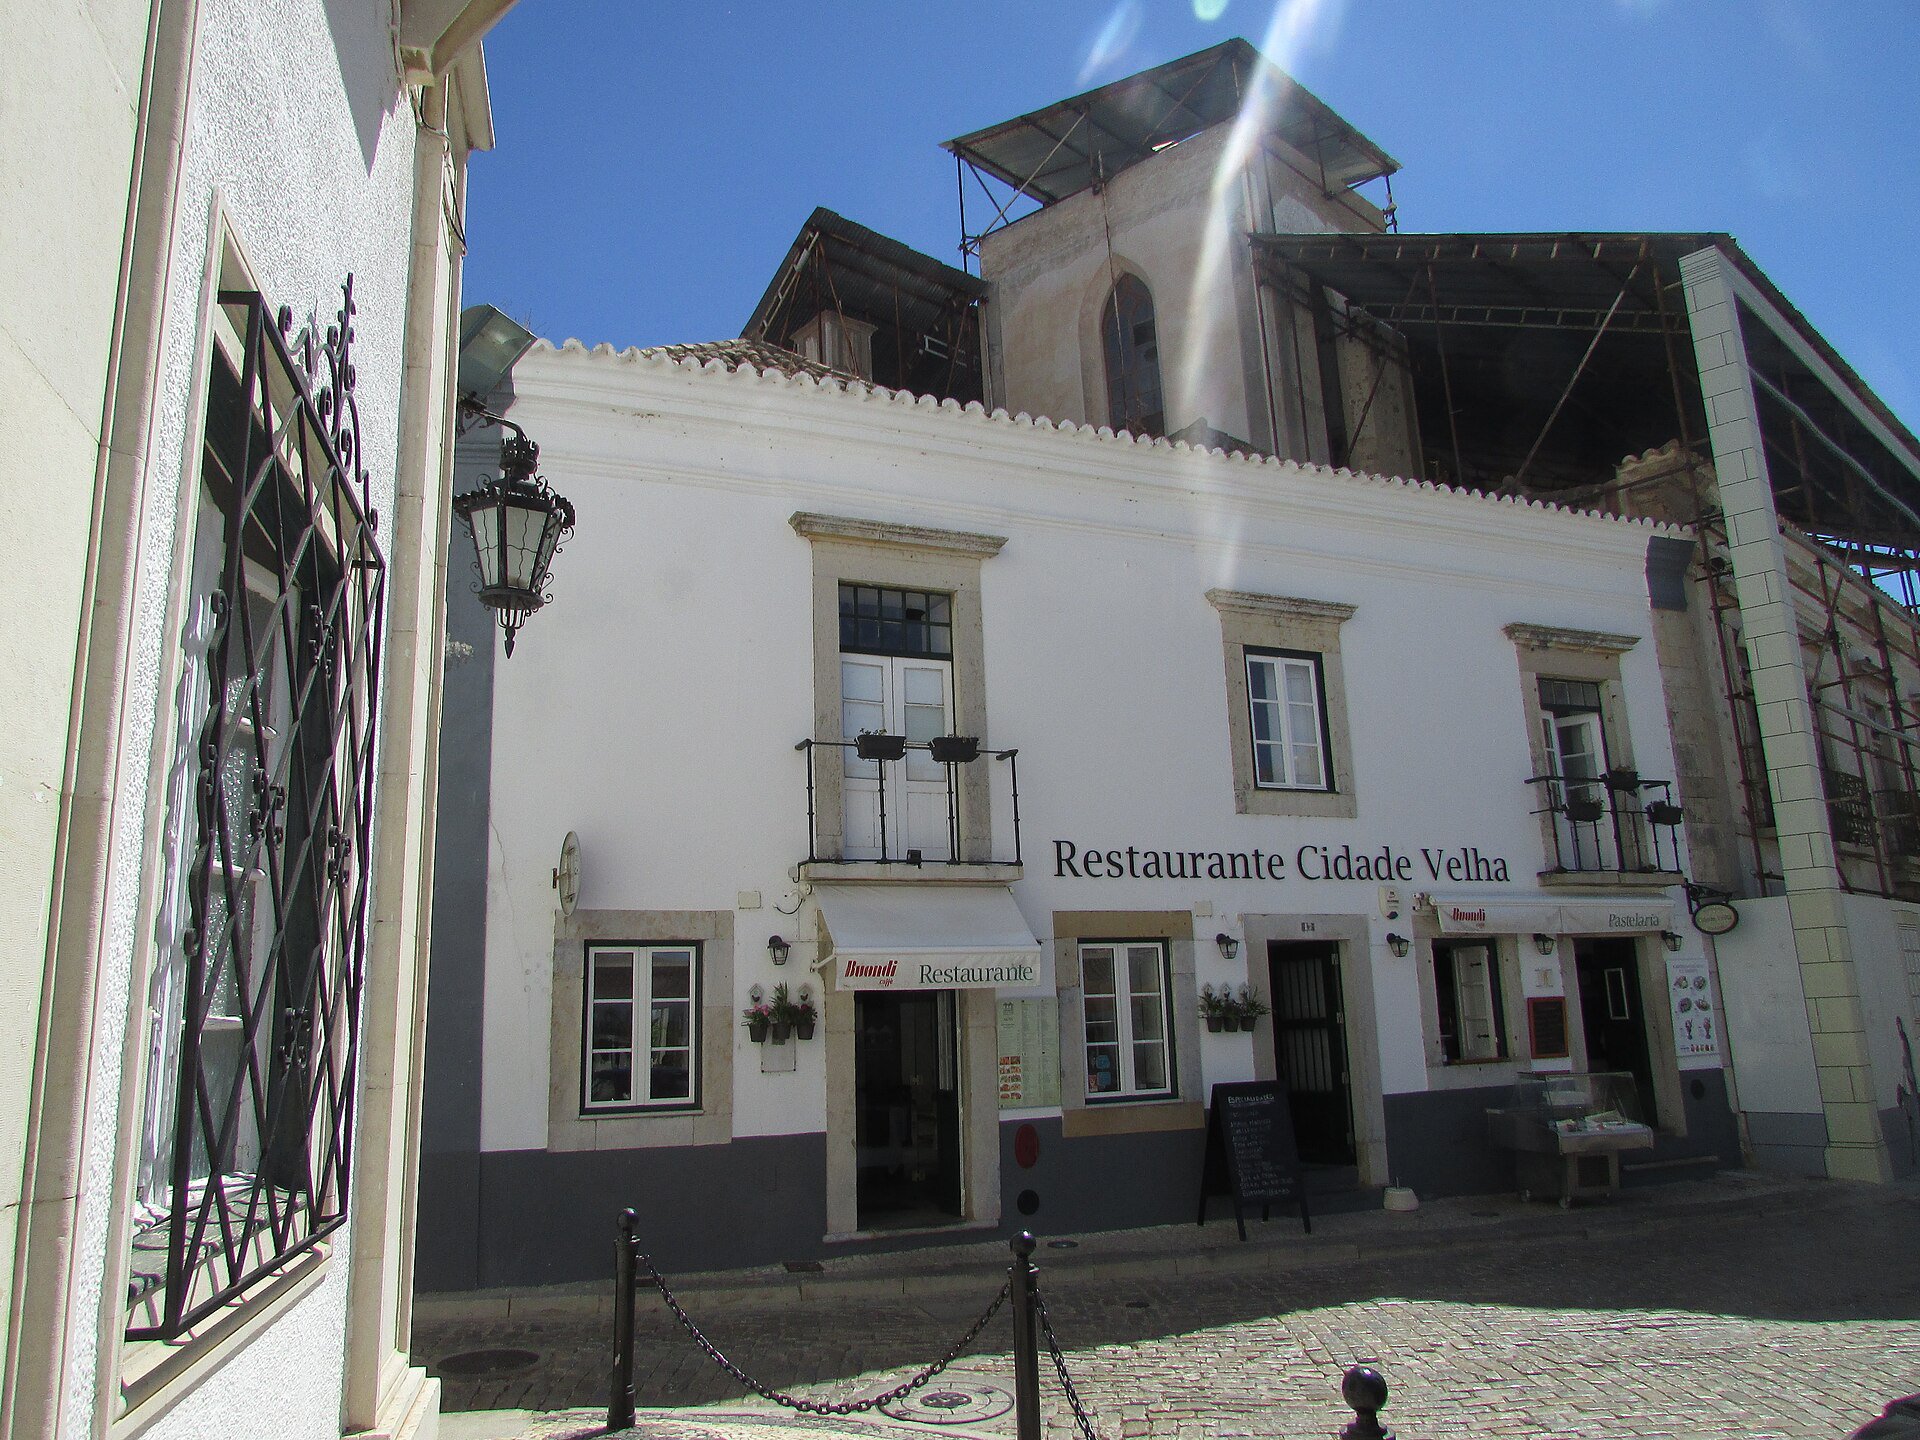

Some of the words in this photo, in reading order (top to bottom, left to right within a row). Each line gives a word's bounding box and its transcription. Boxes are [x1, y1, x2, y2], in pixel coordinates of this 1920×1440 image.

[1052, 840, 1286, 881] Restaurante
[1297, 844, 1412, 881] Cidade
[1419, 847, 1511, 882] Velha
[1608, 912, 1660, 928] Pastelaria
[844, 960, 898, 977] Buondi
[919, 963, 1034, 984] Restaurante
